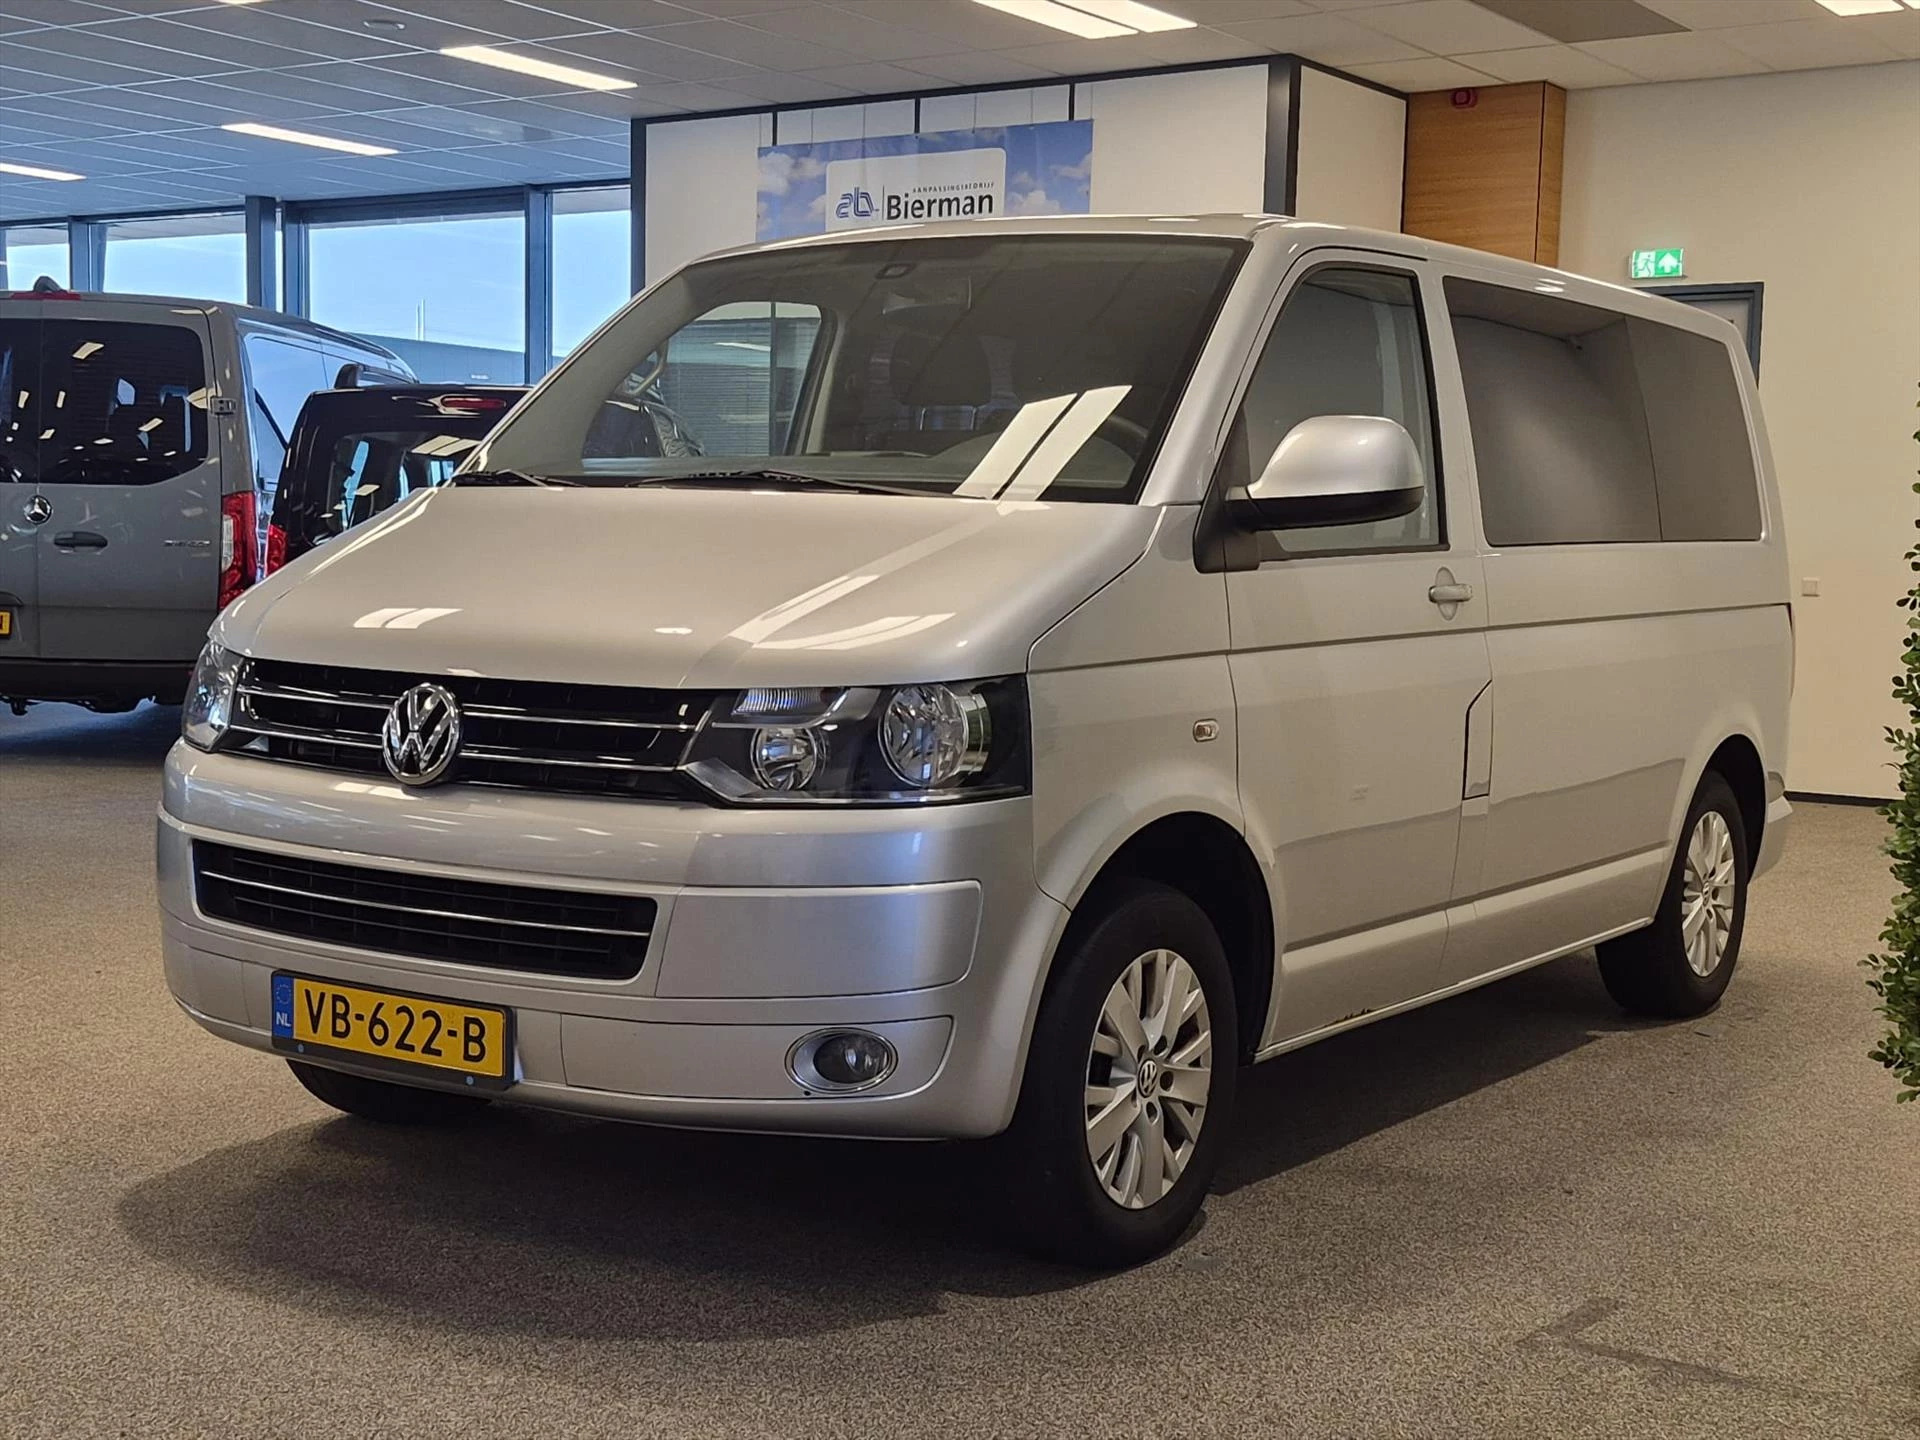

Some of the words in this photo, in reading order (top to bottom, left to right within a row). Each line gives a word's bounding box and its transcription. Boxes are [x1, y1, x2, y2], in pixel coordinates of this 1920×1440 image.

[887, 193, 994, 220] Bierman
[276, 1011, 291, 1027] NL
[304, 988, 486, 1063] VB-622-B
